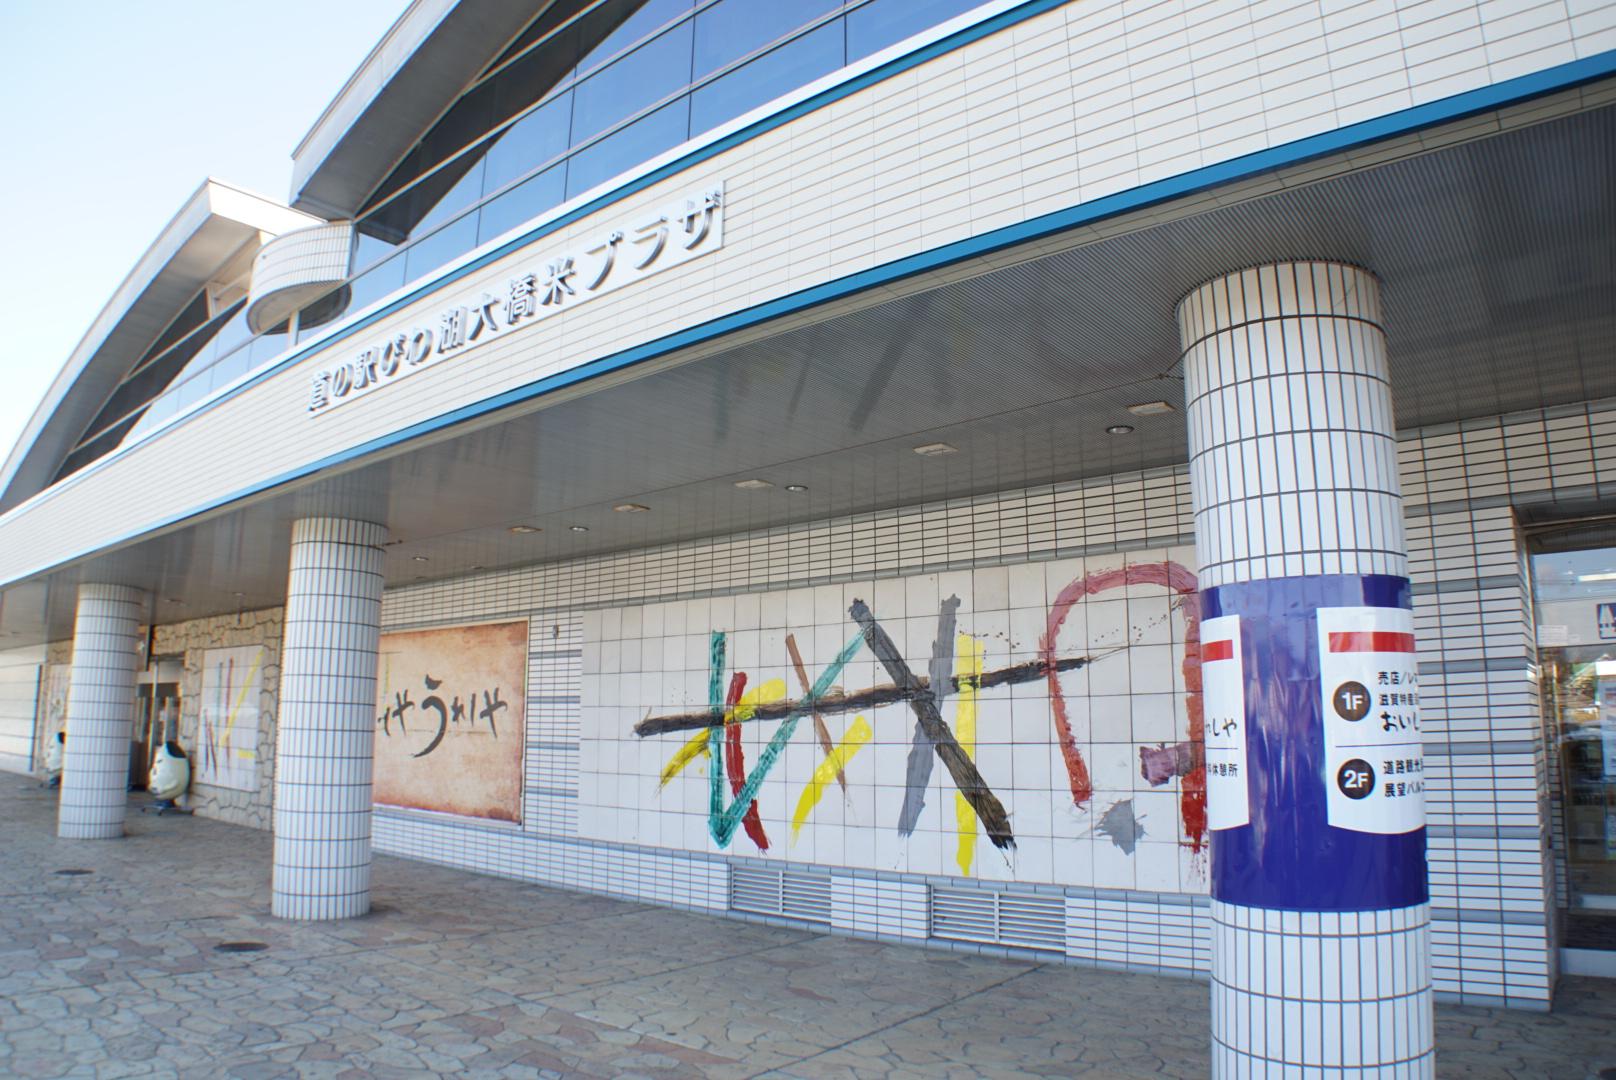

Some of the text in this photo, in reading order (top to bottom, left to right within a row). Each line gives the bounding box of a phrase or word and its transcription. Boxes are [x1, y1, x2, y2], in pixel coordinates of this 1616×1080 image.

[306, 190, 721, 411] 道の駅びわ湖大橋米プラザ
[1341, 691, 1363, 710] 1F
[1344, 769, 1369, 789] 2F
